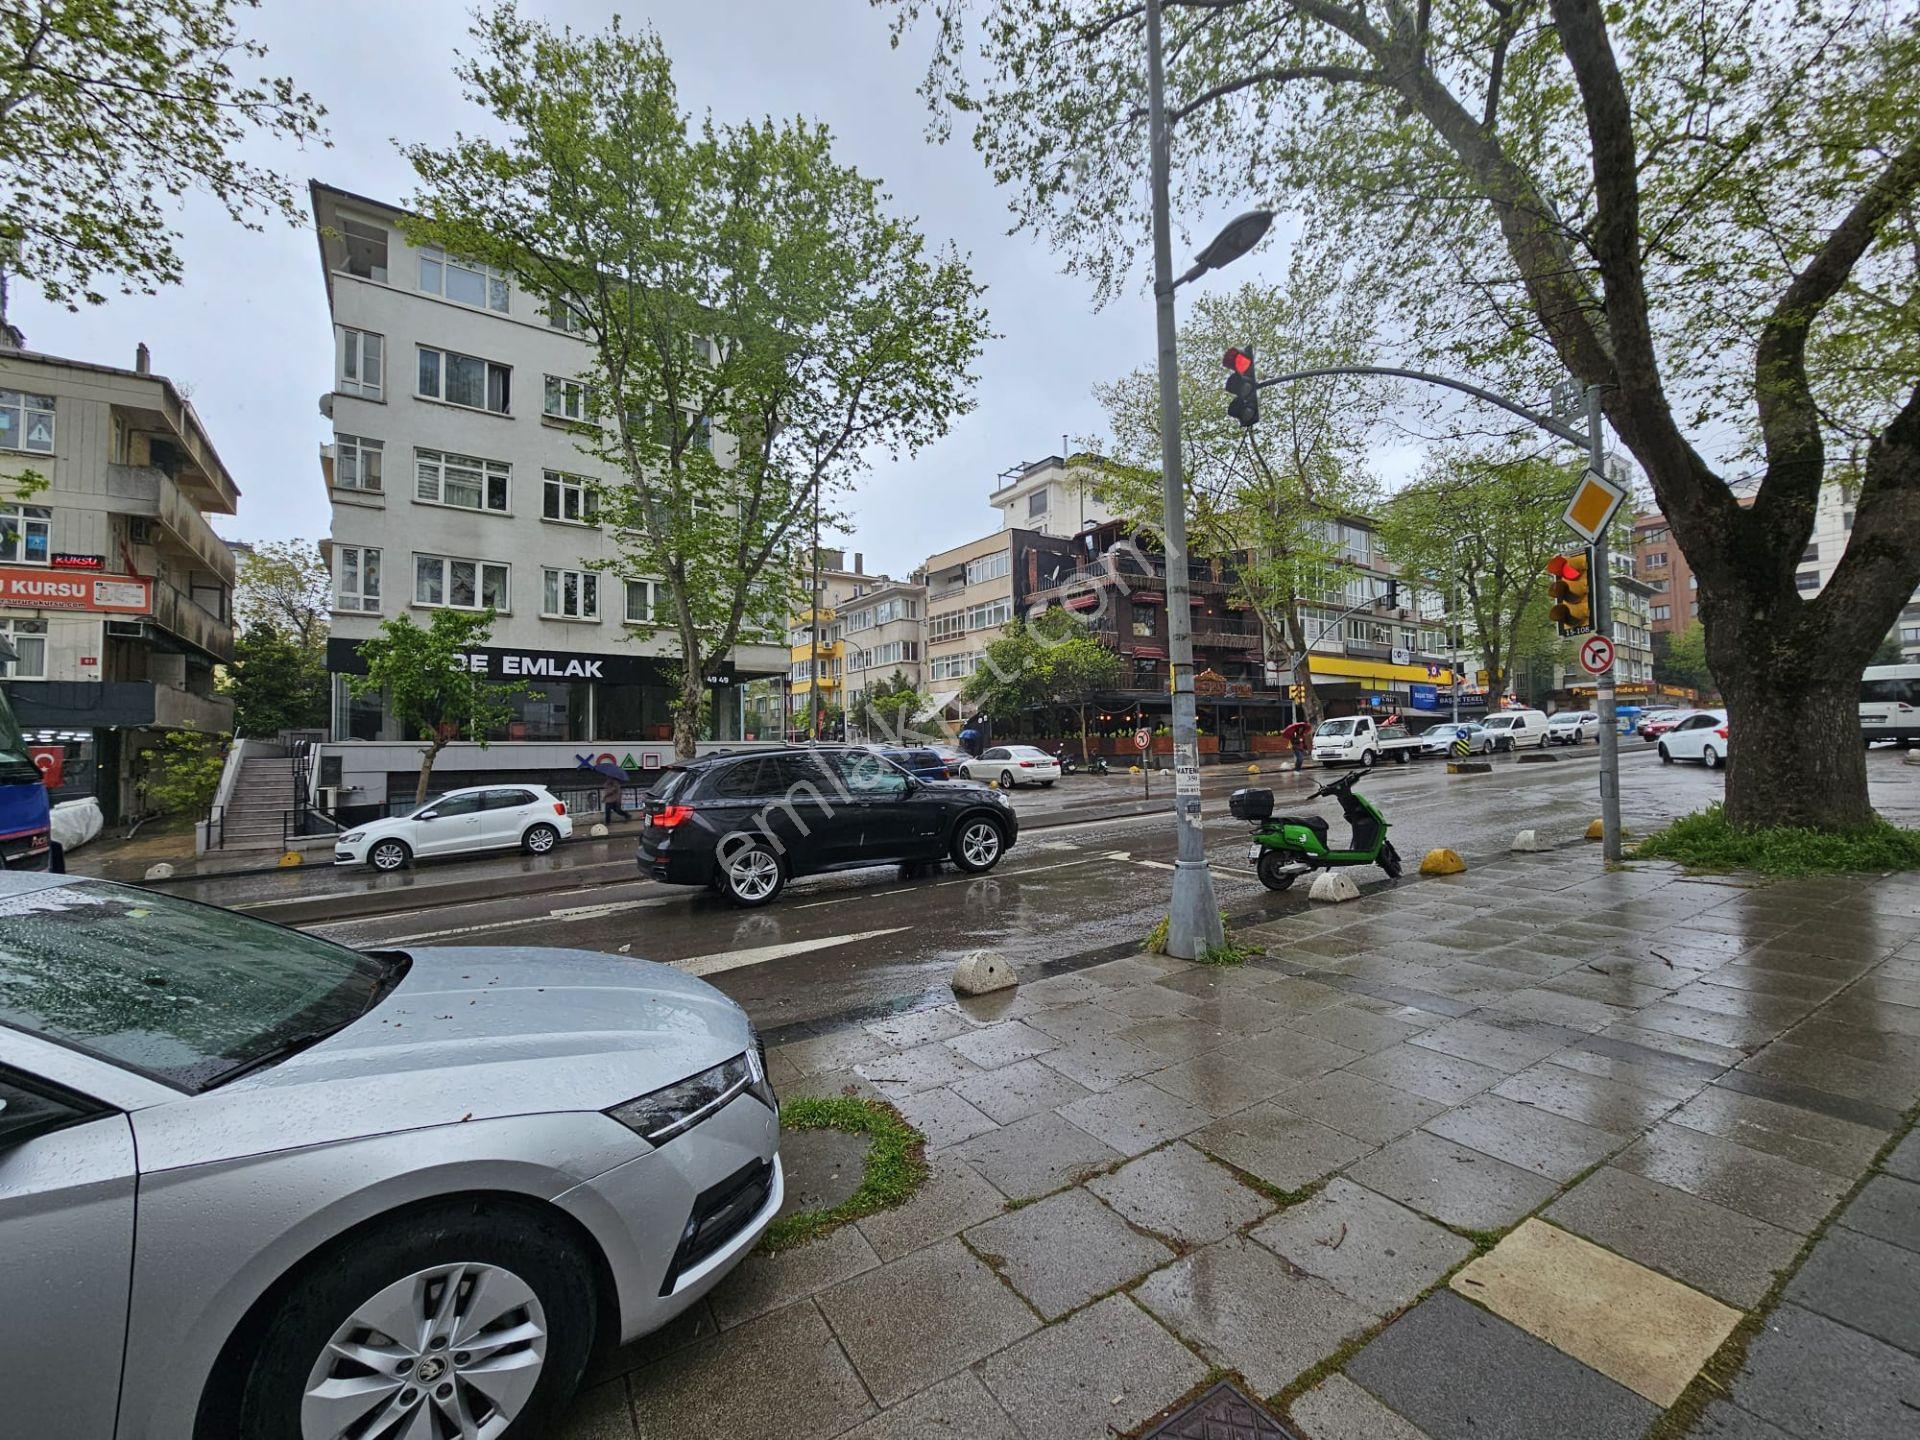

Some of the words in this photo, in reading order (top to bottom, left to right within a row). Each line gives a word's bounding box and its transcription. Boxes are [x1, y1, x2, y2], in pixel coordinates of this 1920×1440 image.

[11, 580, 86, 597] KURSU
[1566, 626, 1590, 636] 15-108
[502, 655, 603, 678] EMLAK
